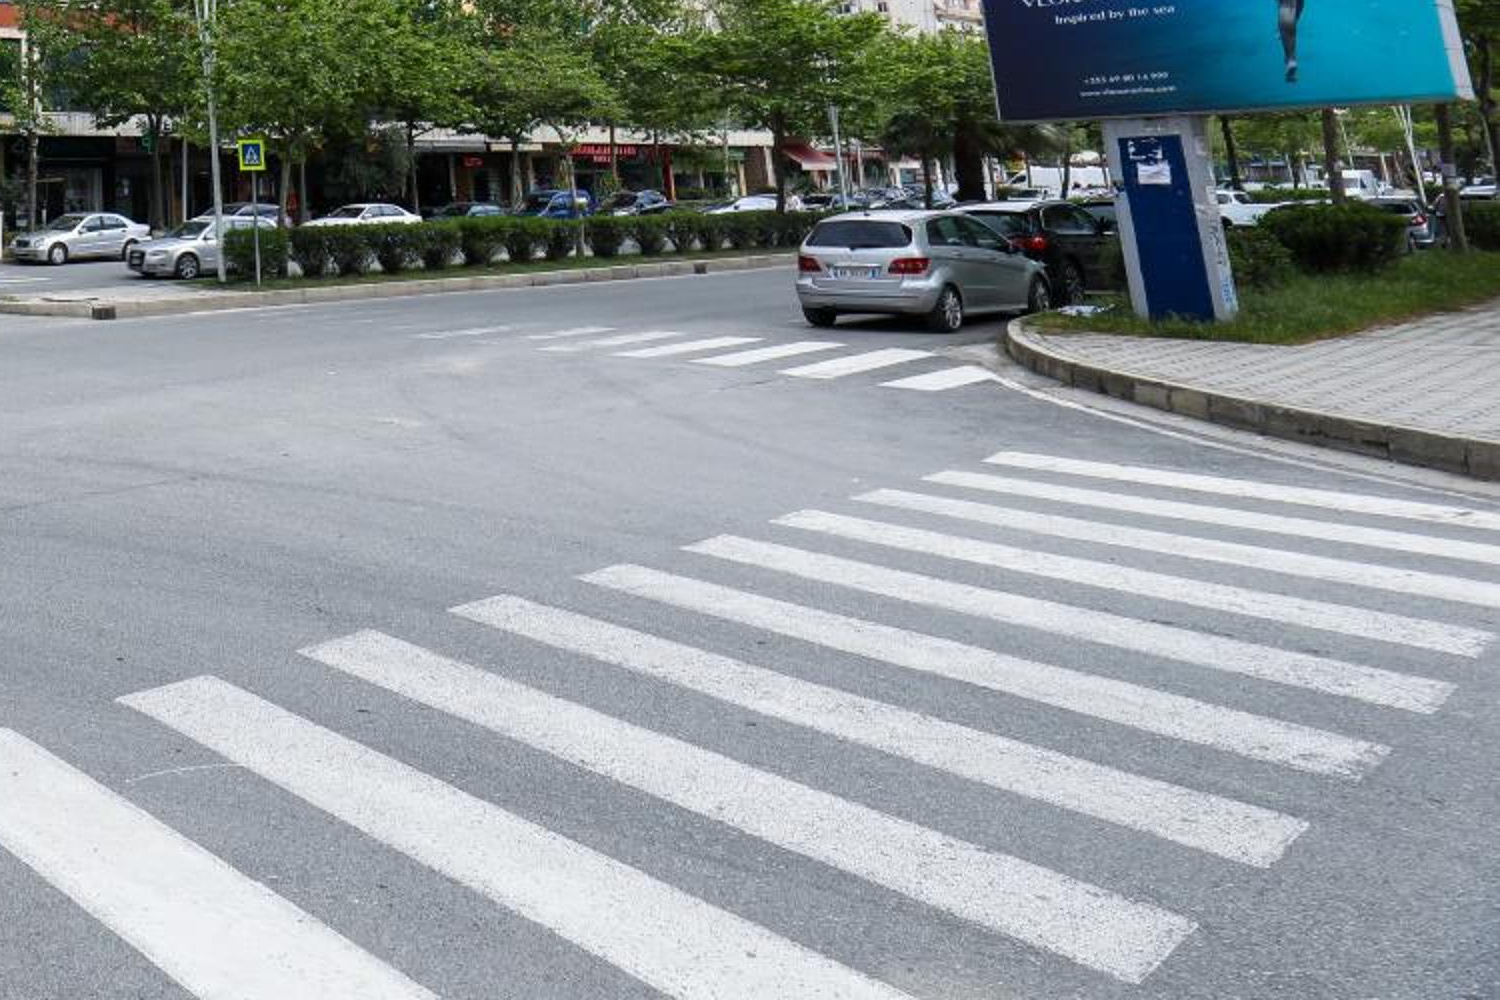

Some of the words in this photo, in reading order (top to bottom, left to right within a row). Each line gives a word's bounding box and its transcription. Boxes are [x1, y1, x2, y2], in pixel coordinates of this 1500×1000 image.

[1054, 9, 1106, 25] Inspired
[1109, 10, 1125, 20] by
[1129, 7, 1149, 17] the
[1153, 5, 1175, 15] sea
